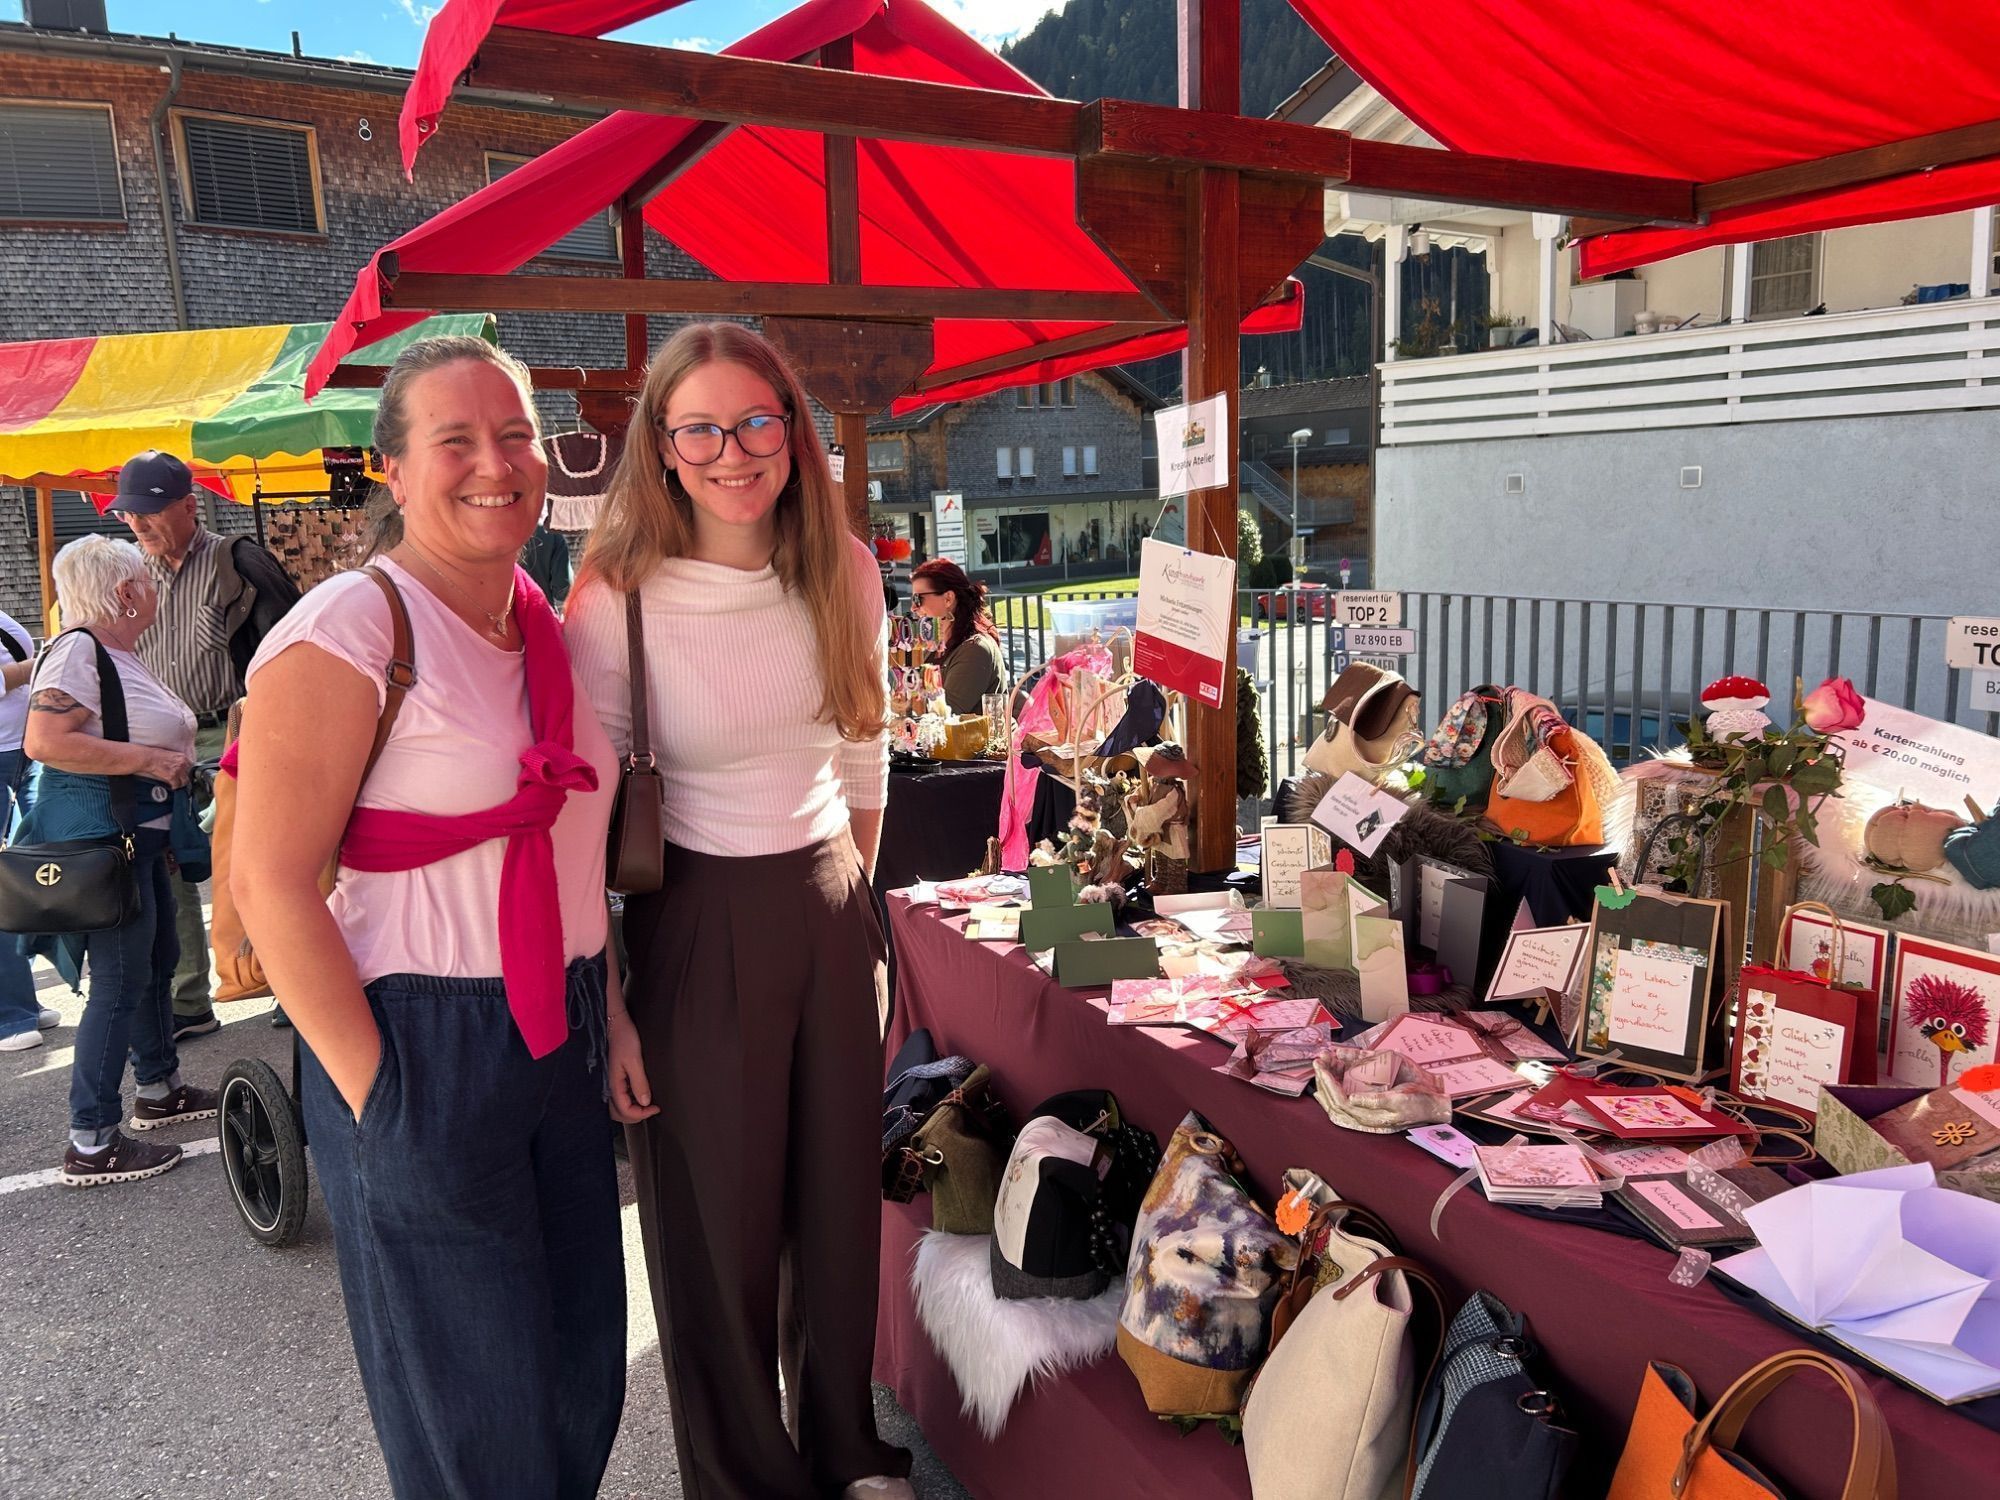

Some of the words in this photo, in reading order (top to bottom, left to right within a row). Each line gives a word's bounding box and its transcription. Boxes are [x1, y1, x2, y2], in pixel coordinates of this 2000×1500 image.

[358, 118, 372, 141] 8
[1193, 453, 1214, 466] Atelier
[1342, 594, 1378, 603] reserviert
[1380, 594, 1391, 603] für
[1348, 606, 1374, 621] TOP
[1379, 607, 1387, 621] 2
[1354, 635, 1365, 645] BZ
[1368, 635, 1386, 646] 890
[1389, 635, 1402, 647] EB
[1873, 727, 1966, 766] Kartenzahlung
[1851, 739, 1869, 750] ab
[1871, 744, 1880, 753] €
[1882, 748, 1918, 766] 20,00
[1919, 761, 1971, 784] möglich
[1619, 968, 1633, 979] Das
[1644, 971, 1681, 987] Leben
[1622, 984, 1640, 994] ist
[1631, 1000, 1648, 1010] kurz
[1652, 1002, 1668, 1021] für
[1781, 1027, 1831, 1050] Glück
[1785, 1046, 1806, 1058] muss
